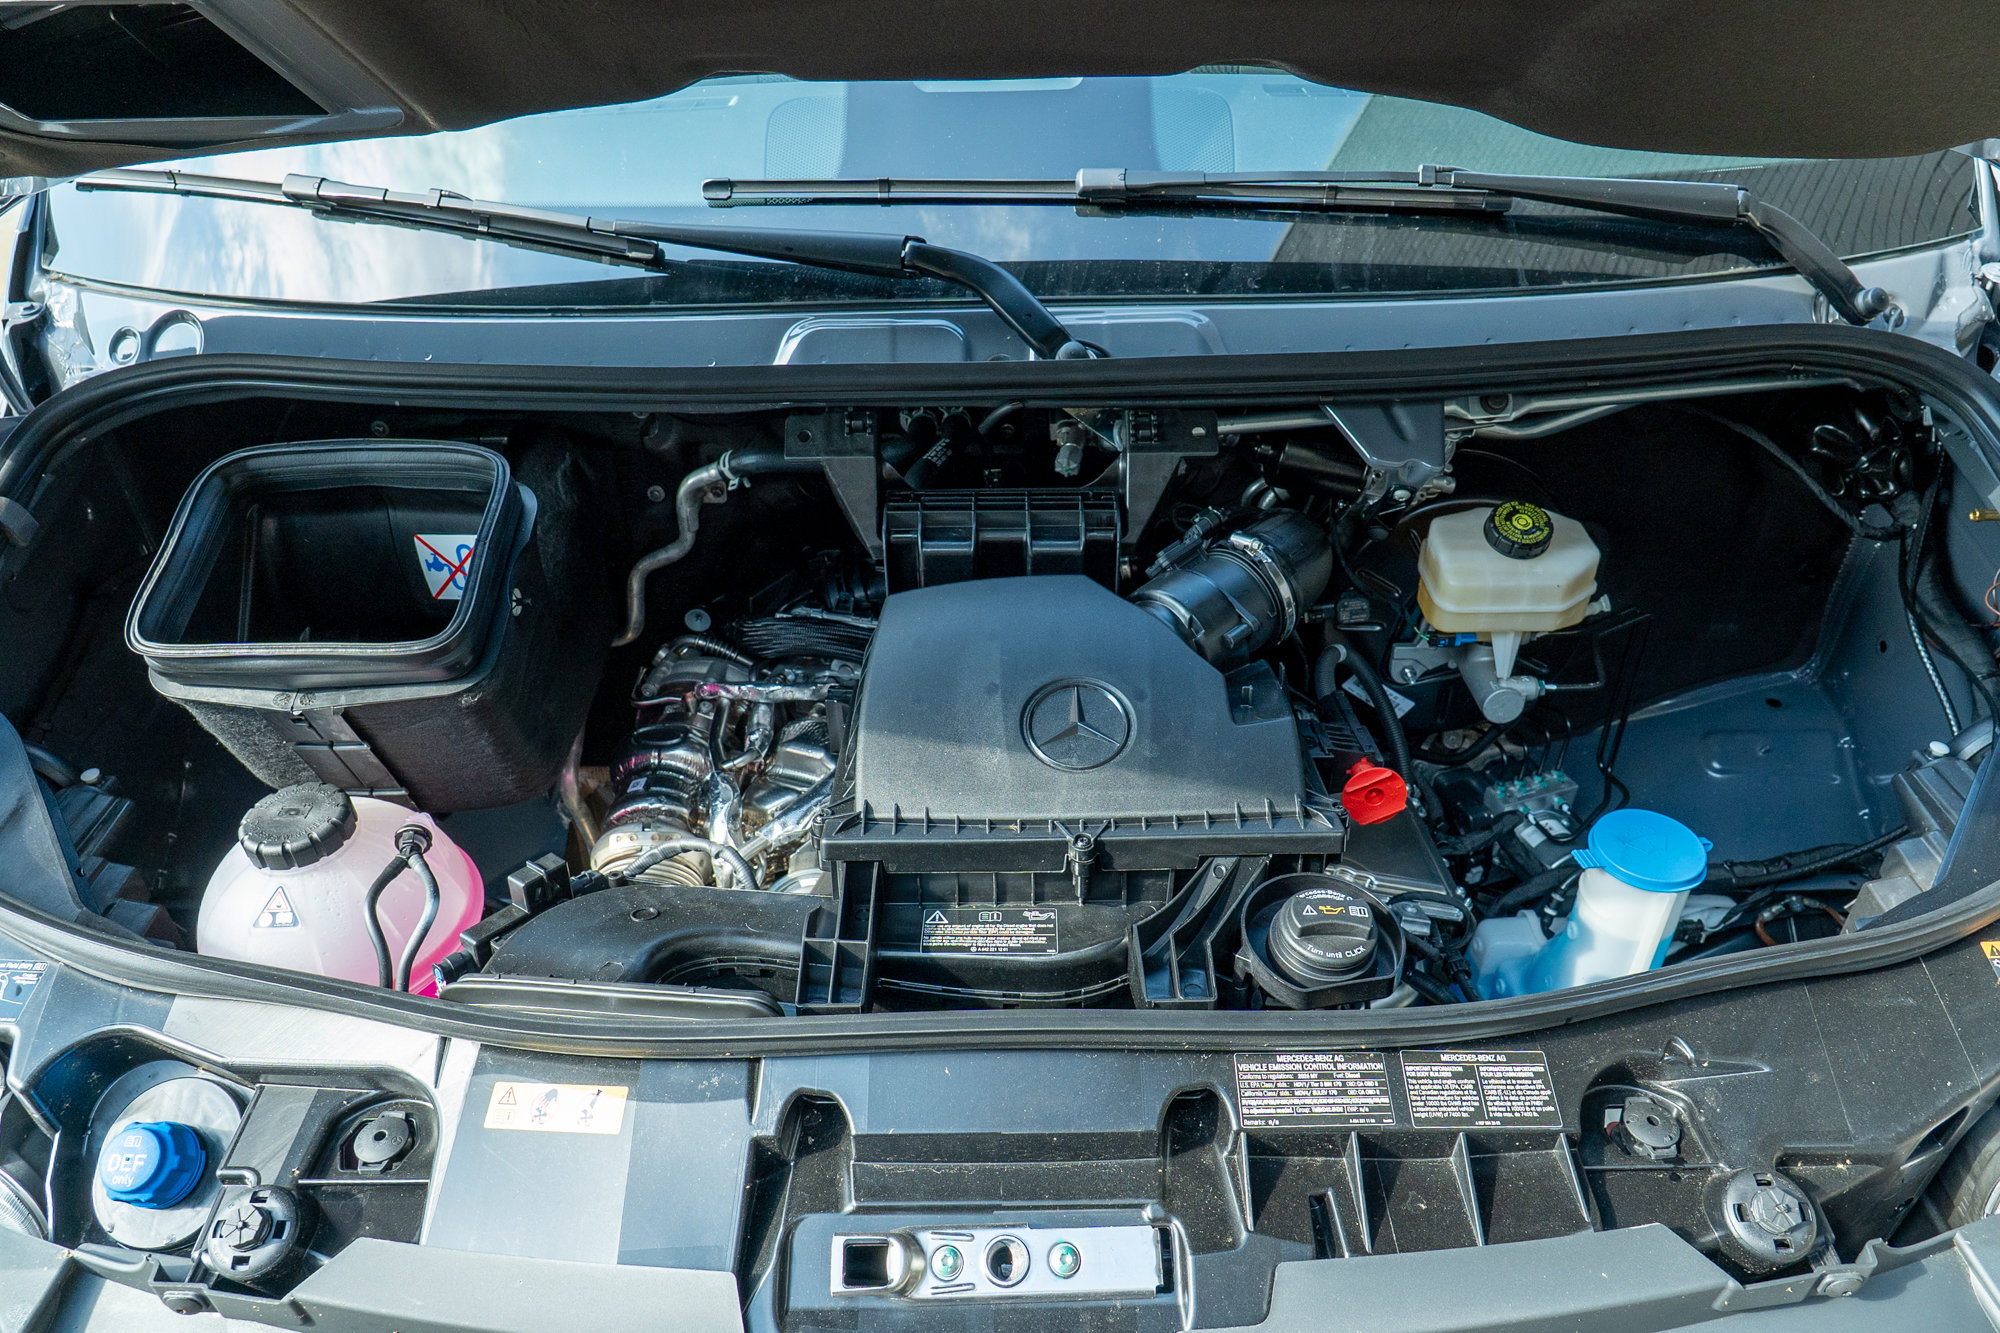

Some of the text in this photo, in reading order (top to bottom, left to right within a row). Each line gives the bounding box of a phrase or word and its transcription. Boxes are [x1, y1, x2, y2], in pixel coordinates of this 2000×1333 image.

[1306, 944, 1323, 956] Turn
[1345, 945, 1366, 957] CLICK
[1440, 1054, 1507, 1062] MERCEDES-BENZ AG
[1238, 1063, 1384, 1071] VEHICLE EMISSION CONTROL INFORMATION
[107, 1154, 147, 1172] DEF
[111, 1173, 134, 1187] only
